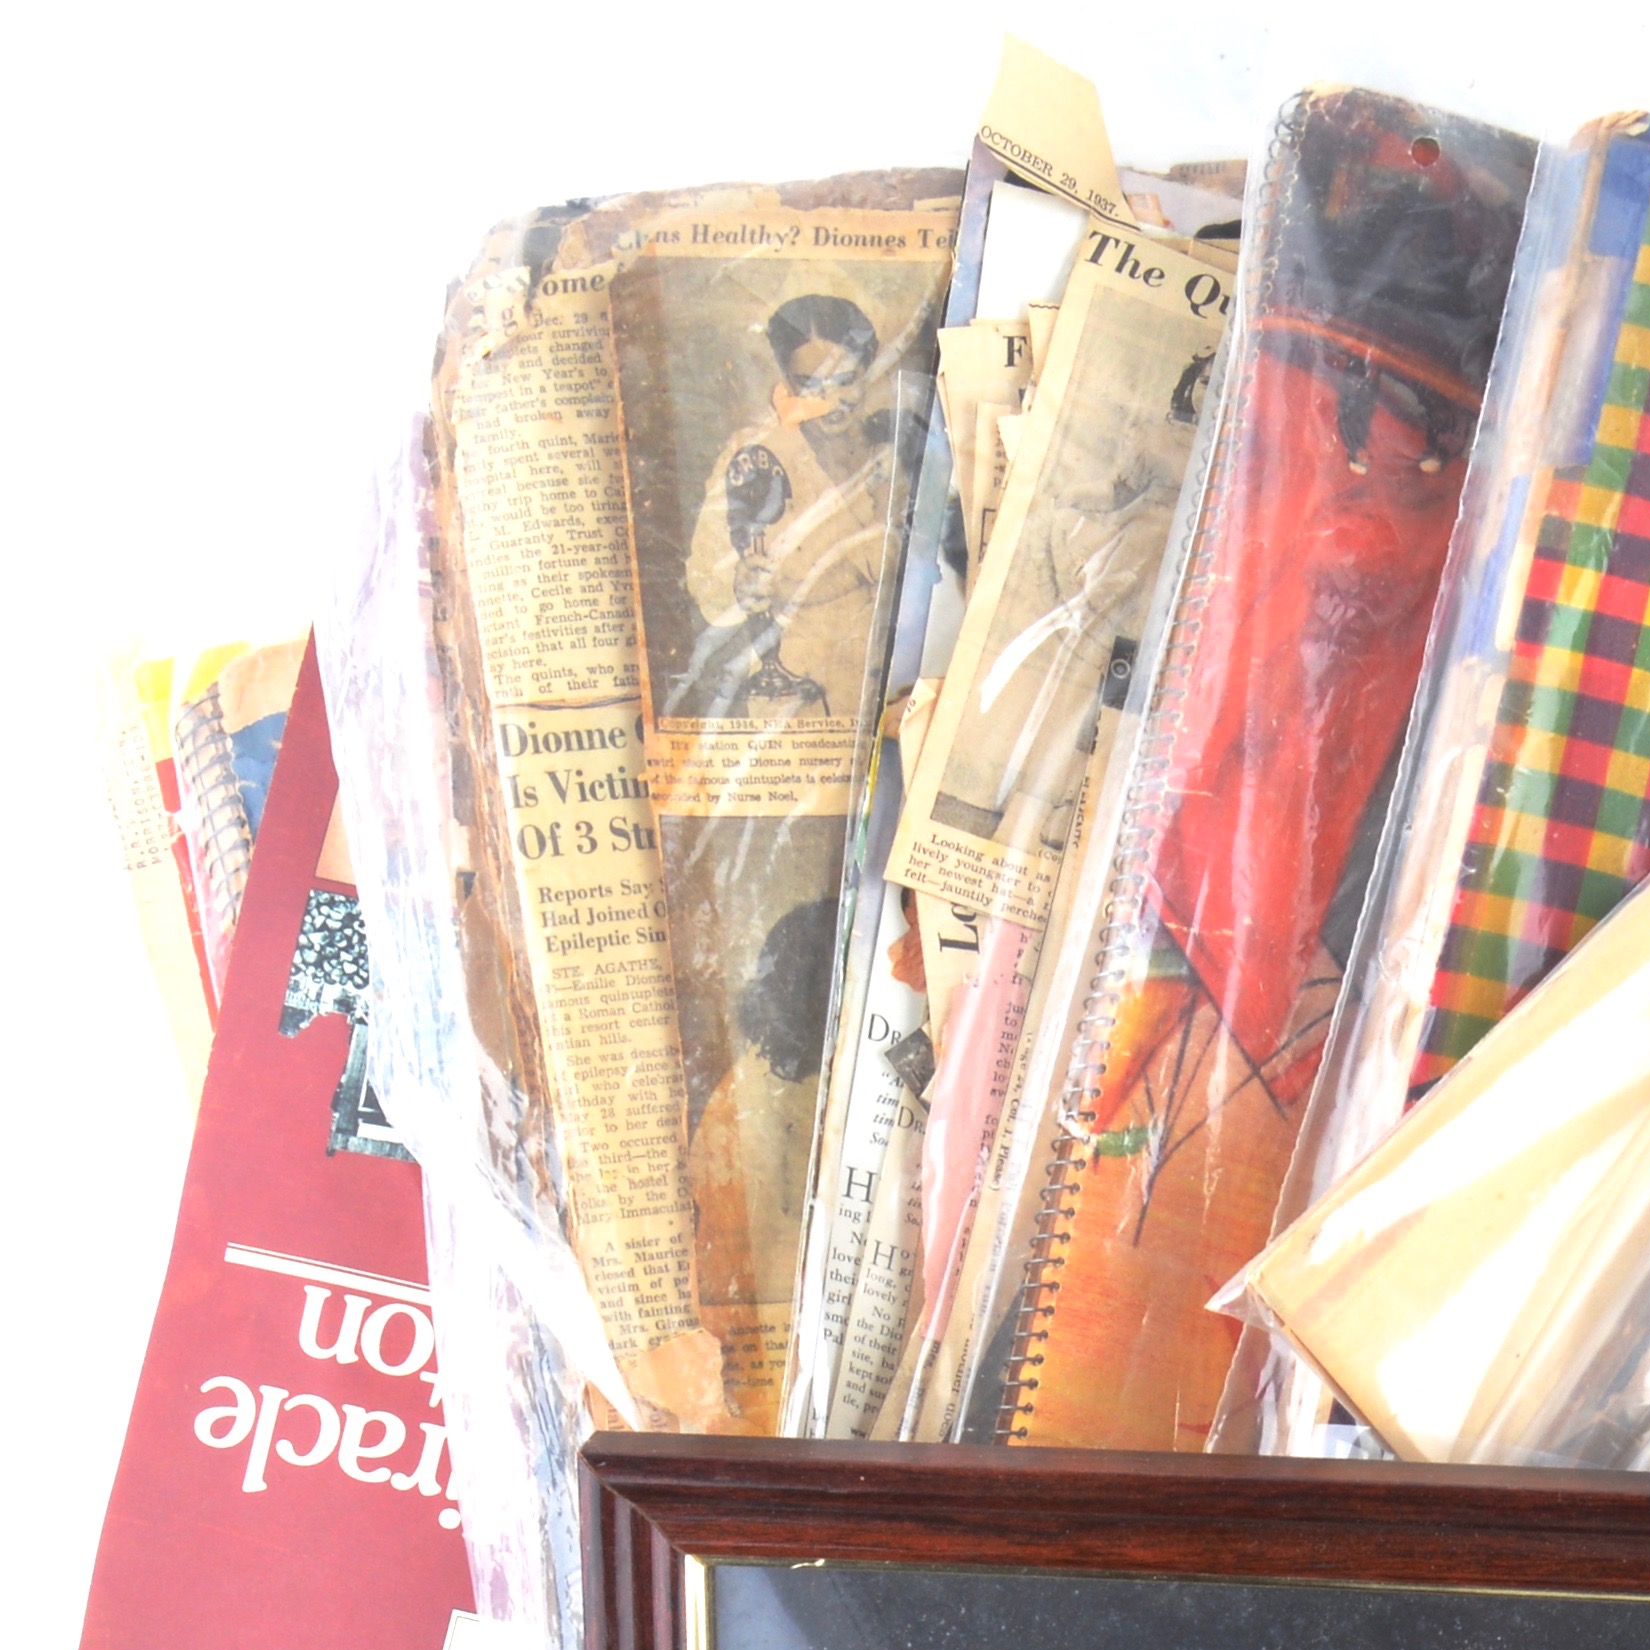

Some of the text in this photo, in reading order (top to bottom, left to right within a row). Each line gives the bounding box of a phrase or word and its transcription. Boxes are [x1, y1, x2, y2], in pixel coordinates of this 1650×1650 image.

[980, 124, 1120, 217] OCTOBER 29, 1937.
[691, 224, 801, 253] Healthy?
[813, 226, 906, 249] Dionnes
[1084, 230, 1165, 288] The
[551, 354, 602, 366] decided
[576, 407, 610, 419] away
[499, 721, 627, 757] Dionne
[506, 774, 539, 809] Is
[517, 821, 564, 860] Of
[575, 820, 598, 854] 3
[908, 854, 931, 870] her
[938, 866, 984, 888] newest
[913, 842, 1041, 894] lively youngster to
[932, 833, 1051, 883] Looking about as
[538, 879, 653, 906] Reports Say
[541, 903, 649, 928] Had Joined
[545, 930, 632, 956] Epileptic
[863, 1282, 898, 1306] lovely
[856, 1316, 874, 1334] the
[873, 1305, 891, 1322] No
[854, 1334, 897, 1356] of their
[848, 1362, 873, 1381] kept
[846, 1379, 866, 1394] and
